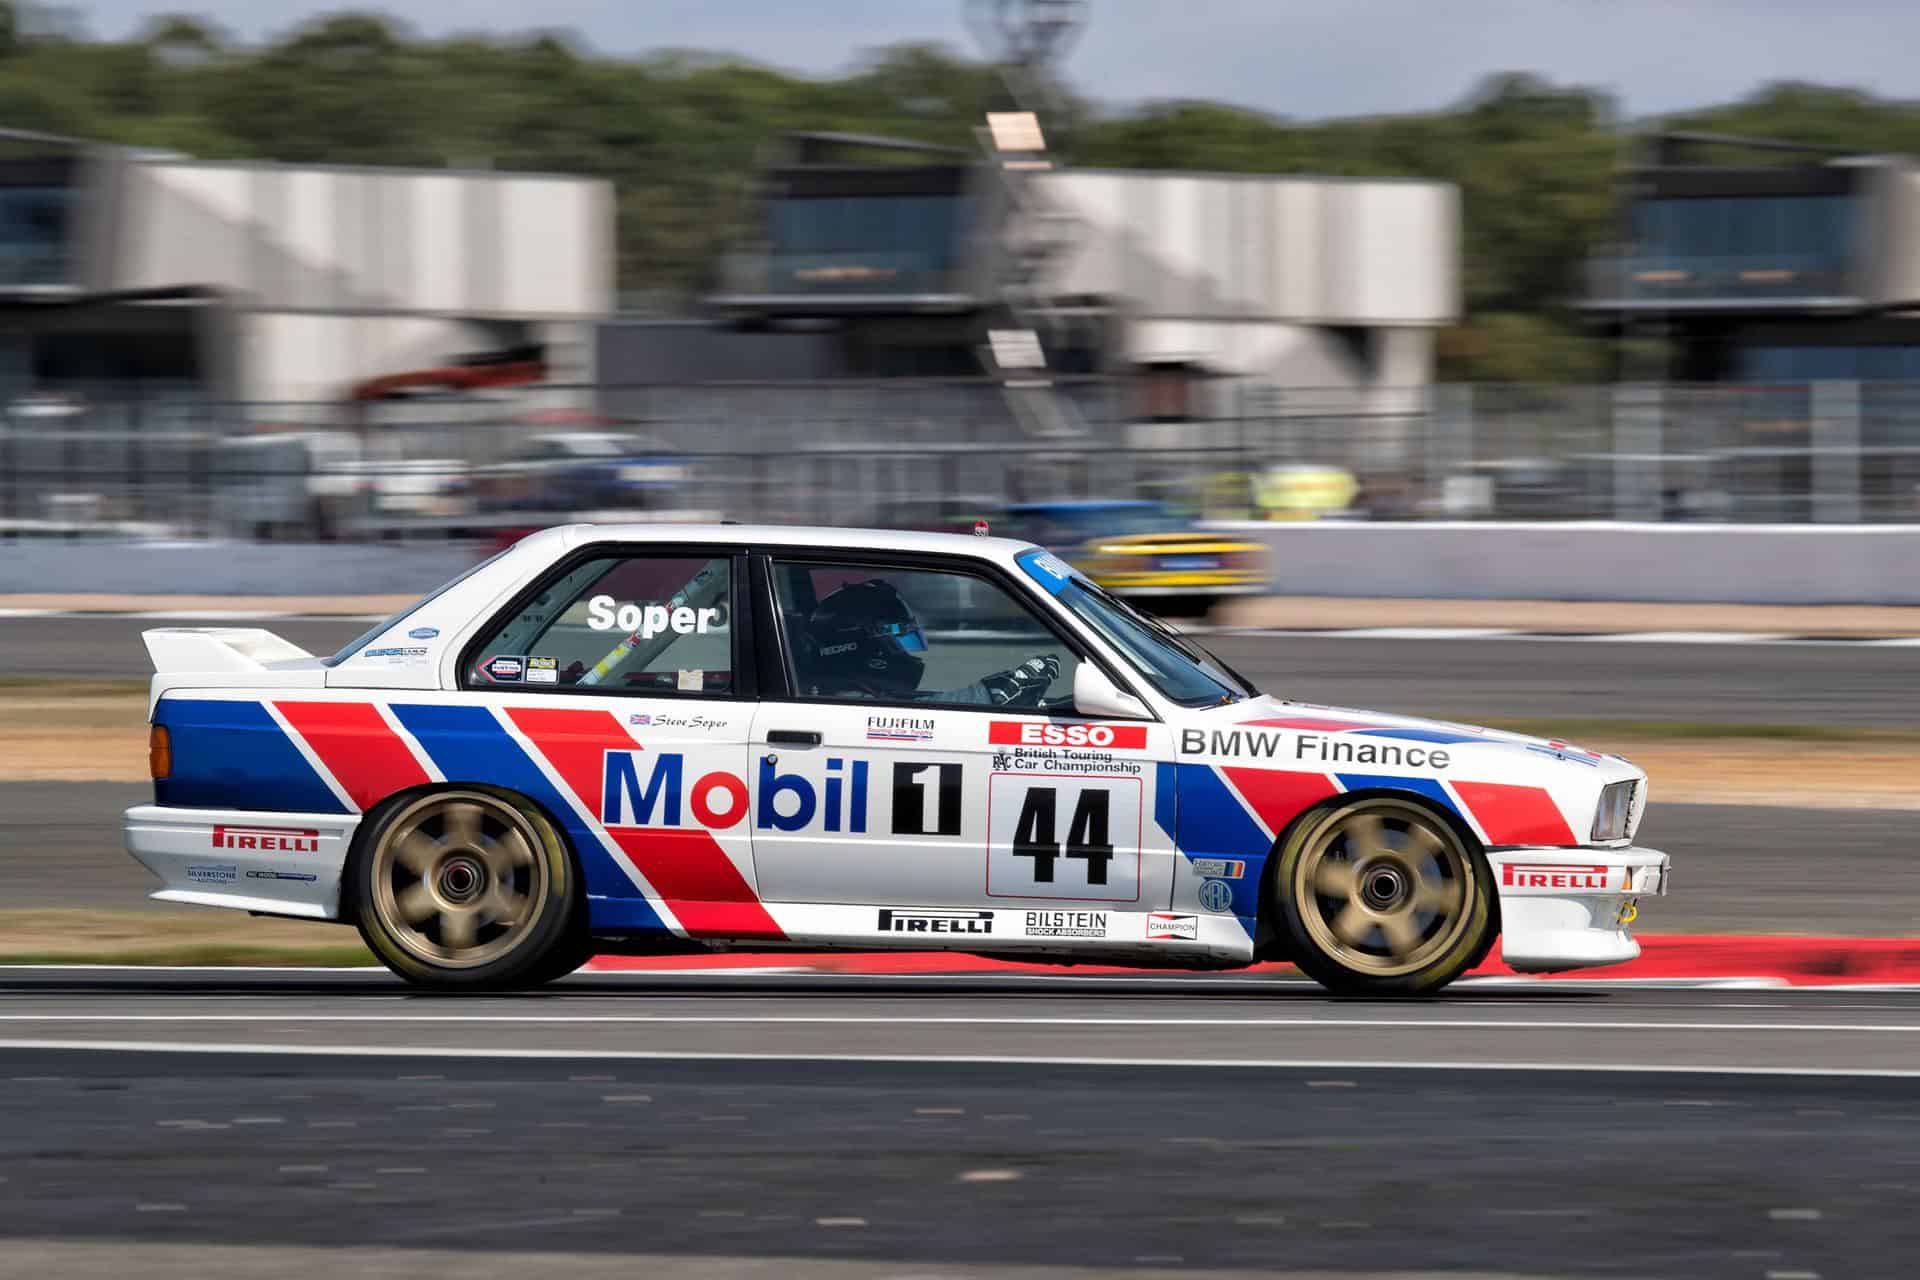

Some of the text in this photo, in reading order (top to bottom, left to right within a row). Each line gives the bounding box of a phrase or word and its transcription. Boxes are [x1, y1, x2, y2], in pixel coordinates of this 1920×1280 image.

[587, 595, 716, 638] Soper
[868, 716, 934, 729] FUJIFILM
[1021, 723, 1115, 746] ESSO
[1014, 748, 1112, 762] British Touring
[1181, 729, 1450, 769] BMW Finance
[1014, 758, 1141, 775] Car Championship
[603, 750, 941, 833] Mobil 1
[212, 824, 319, 852] PIRELLI
[1013, 787, 1113, 884] 44
[1503, 863, 1607, 888] PIRELLI
[878, 909, 993, 933] PIRELLI
[1026, 912, 1106, 928] BILSTEIN
[1150, 924, 1195, 932] CHAMPION
[1027, 928, 1055, 936] SHOCK
